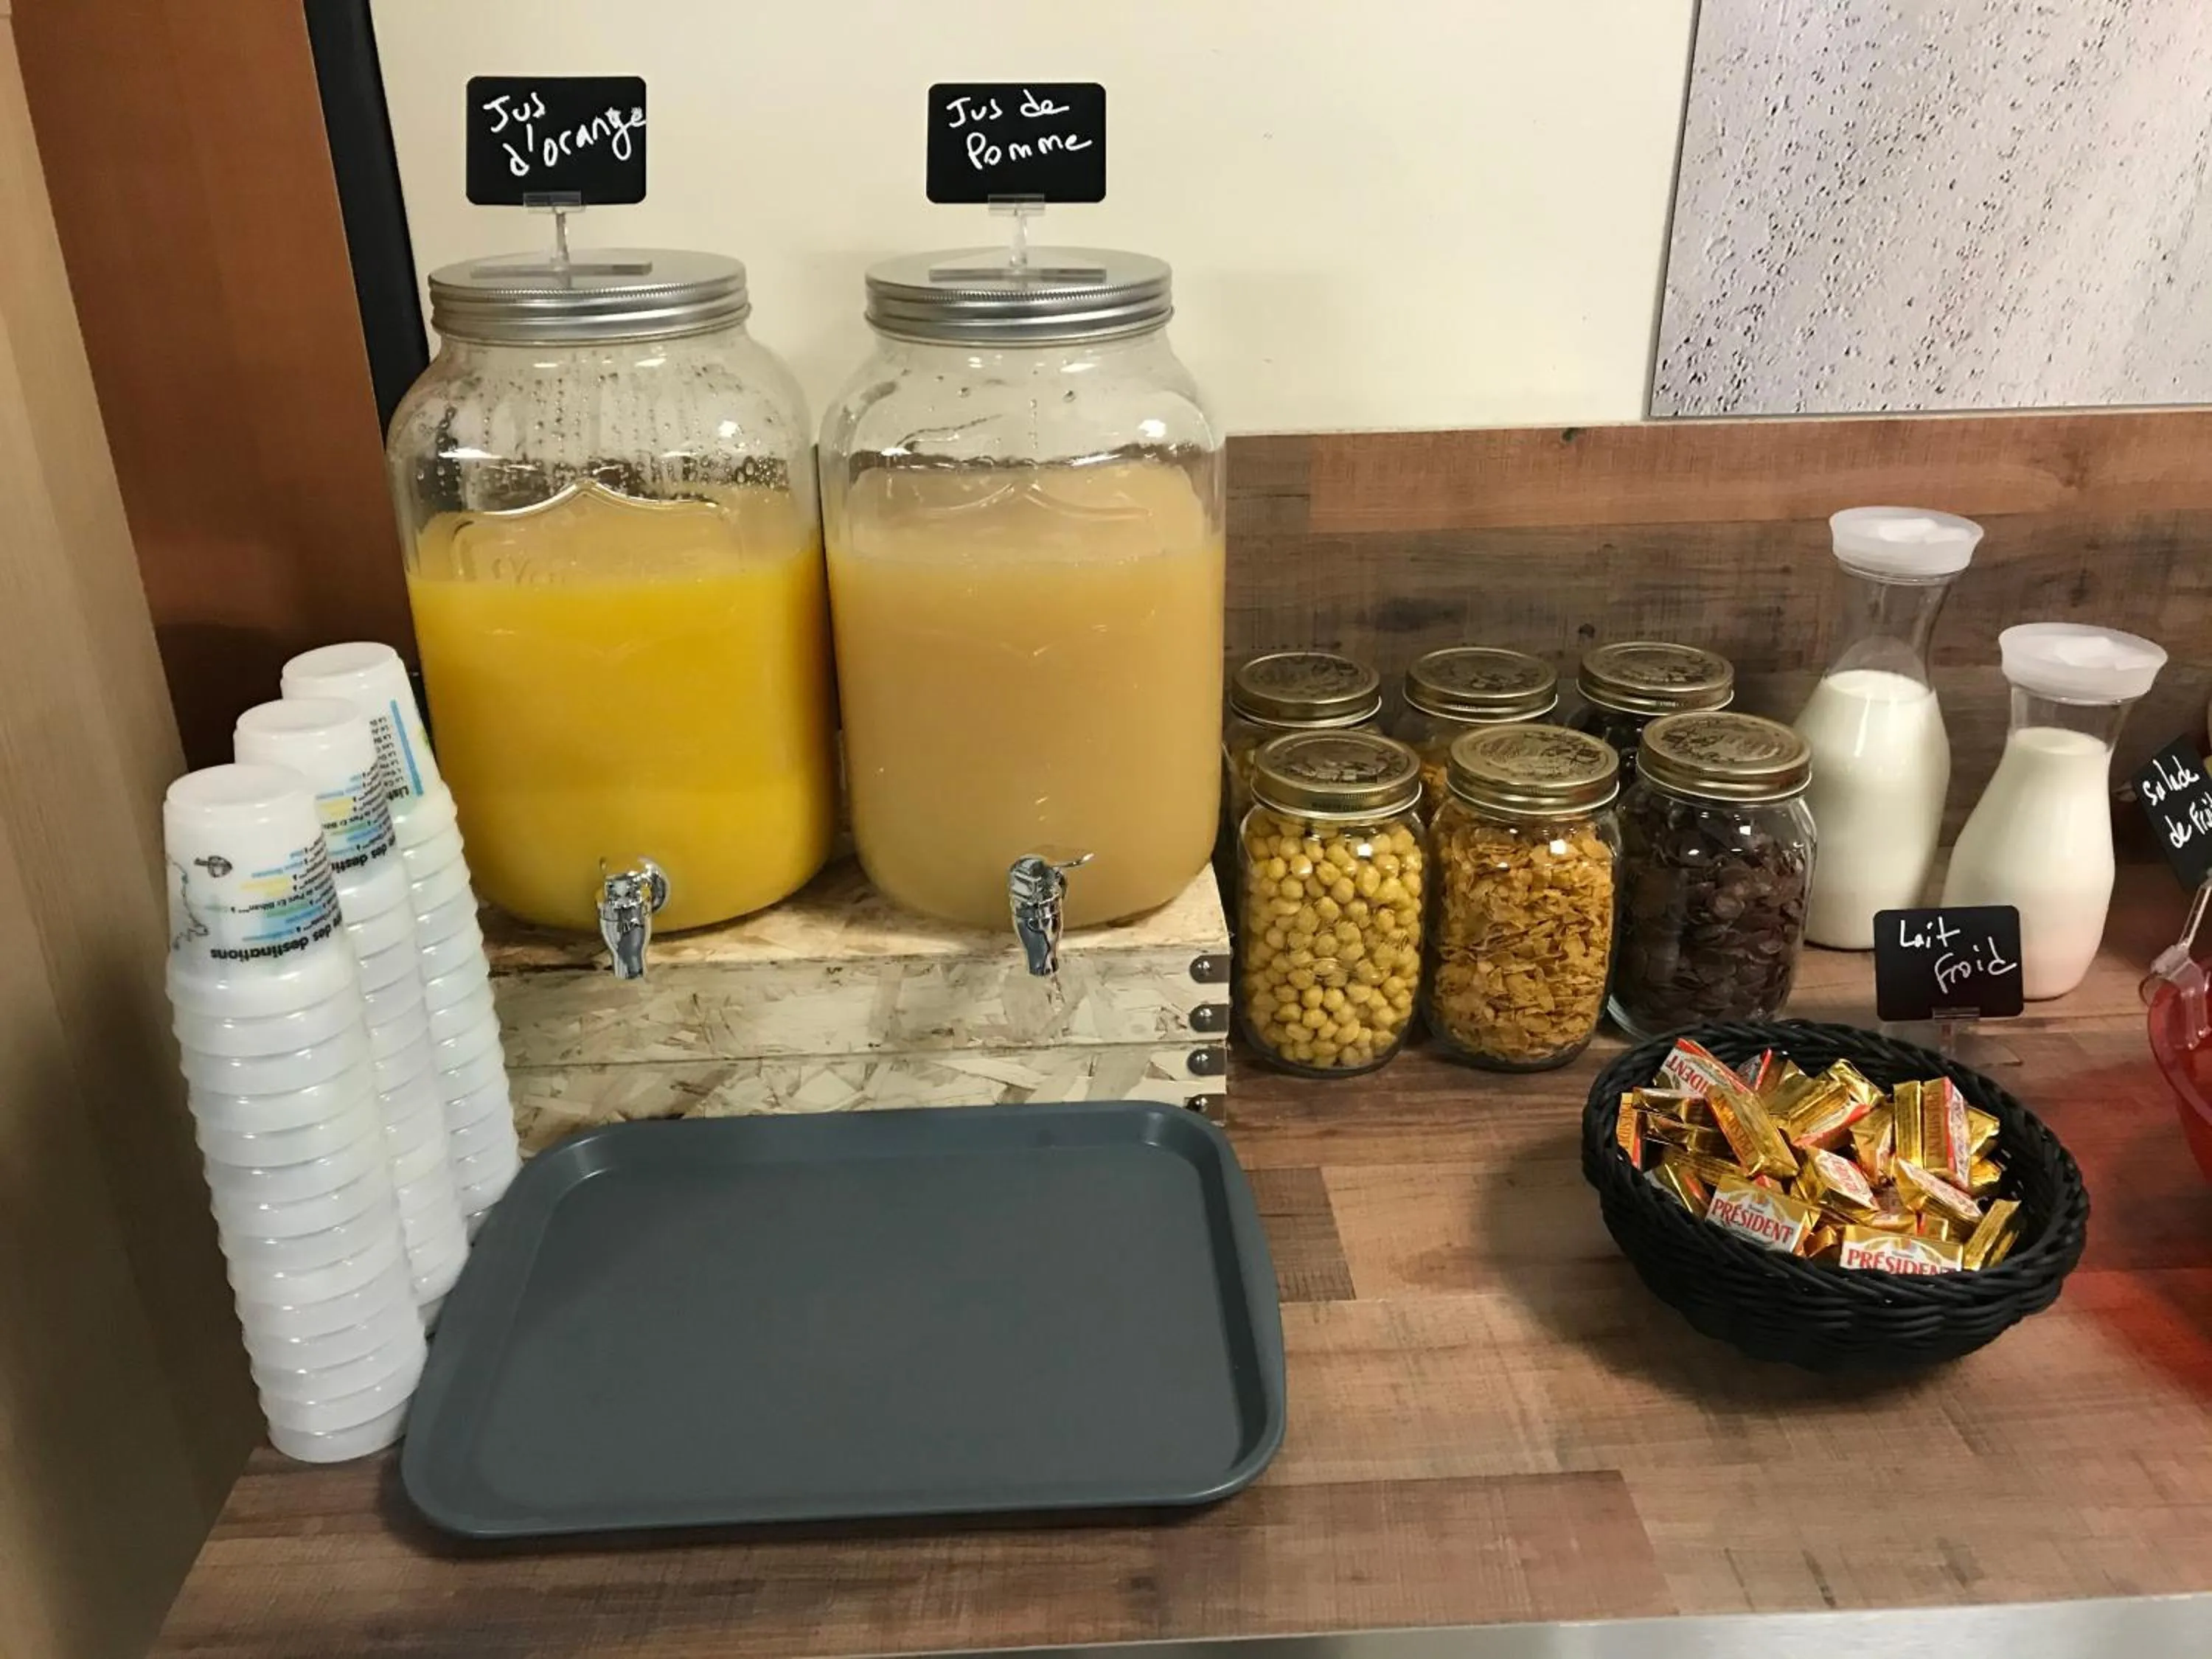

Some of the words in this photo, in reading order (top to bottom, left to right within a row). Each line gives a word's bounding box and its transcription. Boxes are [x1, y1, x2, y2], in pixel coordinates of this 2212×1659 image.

[483, 92, 546, 133] Jus
[946, 97, 1003, 128] Jus
[1020, 89, 1070, 117] de
[2164, 815, 2192, 849] de
[209, 934, 309, 962] destinations
[1899, 916, 1961, 949] Lait
[1665, 1054, 1711, 1093] IDENT
